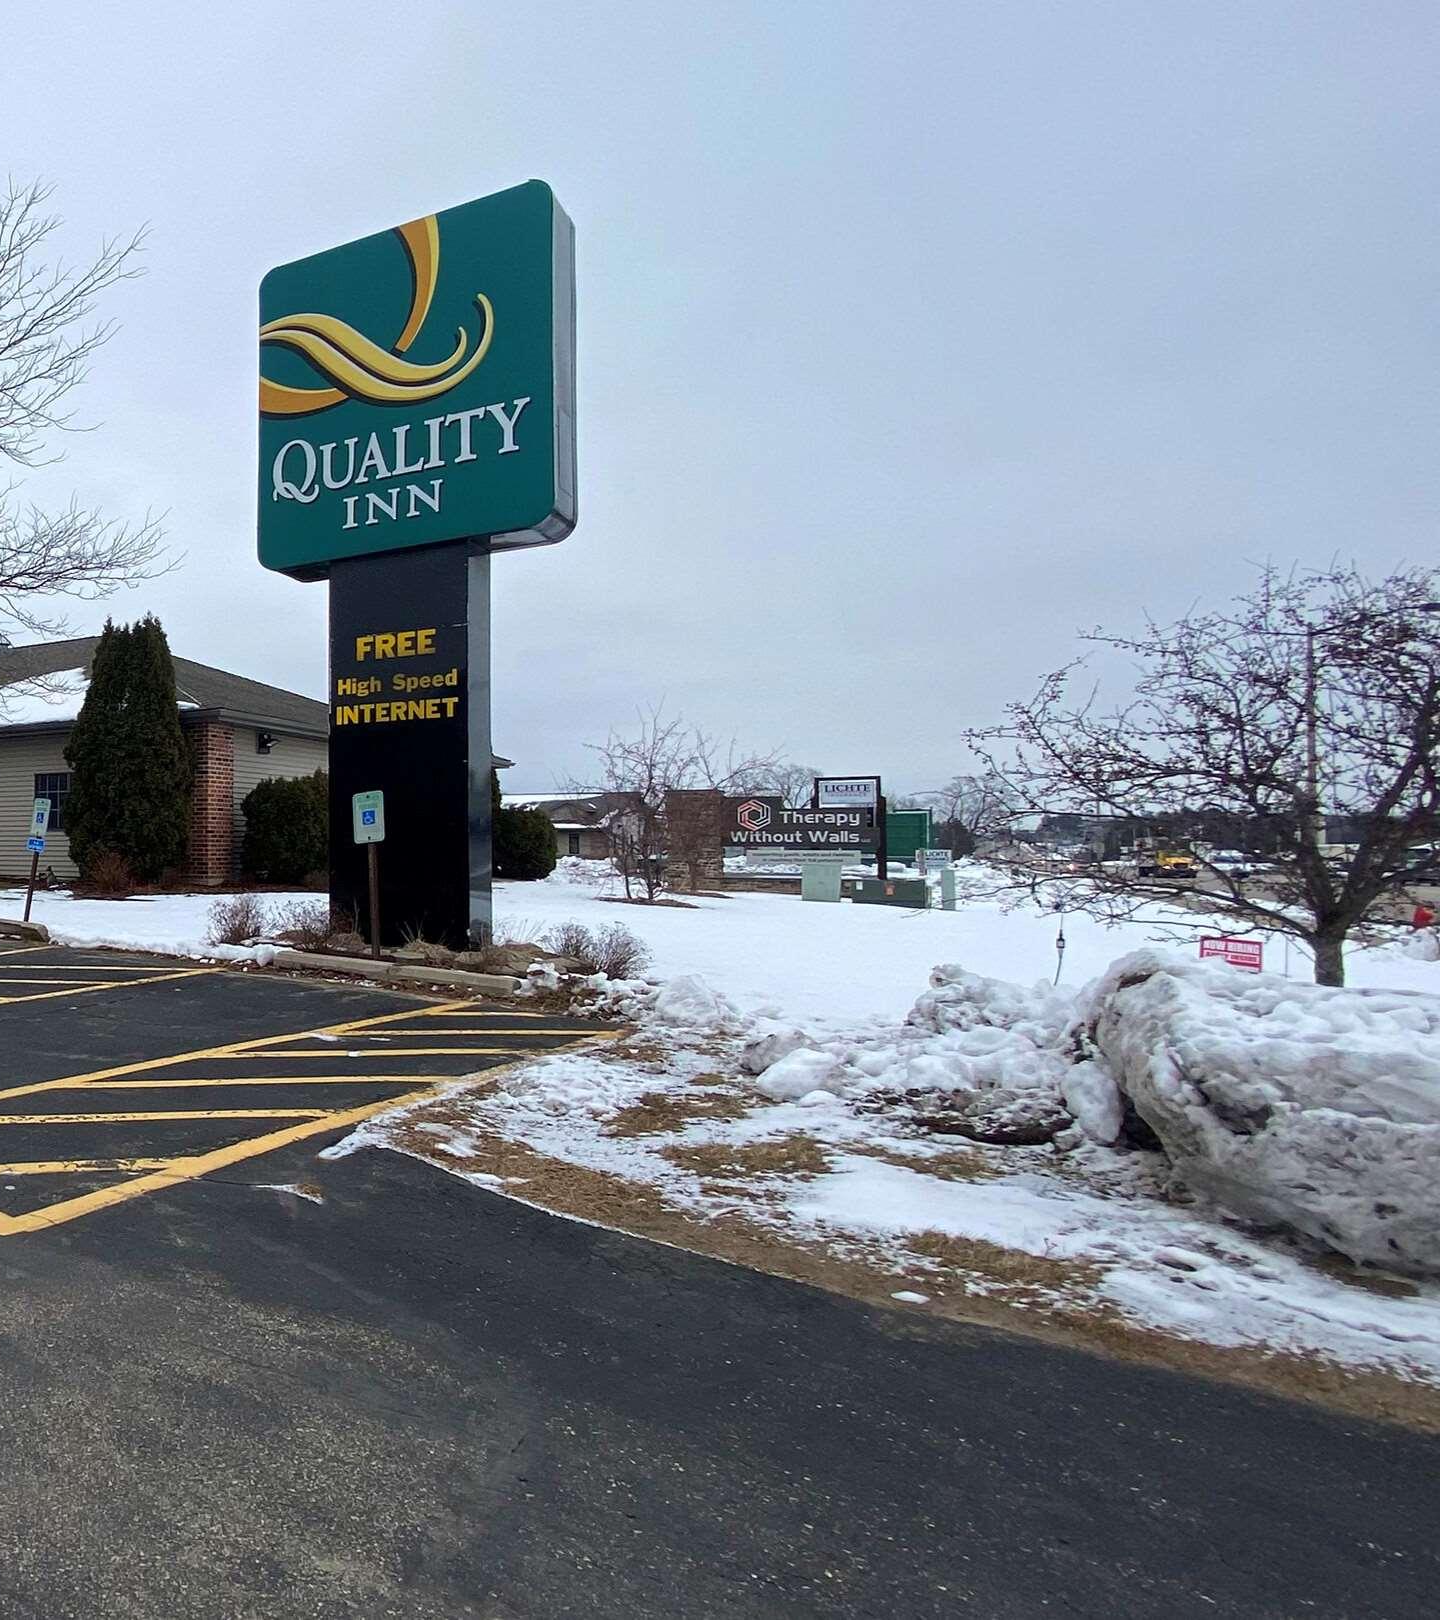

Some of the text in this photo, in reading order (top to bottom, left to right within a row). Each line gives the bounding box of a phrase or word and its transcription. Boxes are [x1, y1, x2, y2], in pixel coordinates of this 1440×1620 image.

[272, 396, 532, 503] QUALITY
[342, 479, 443, 529] INN
[355, 628, 438, 662] FREE
[337, 668, 457, 697] High Speed
[335, 697, 459, 726] INTERNET
[824, 784, 871, 793] LICHTE
[778, 811, 860, 826] Therapy
[730, 830, 803, 843] Without
[807, 830, 860, 843] Walls
